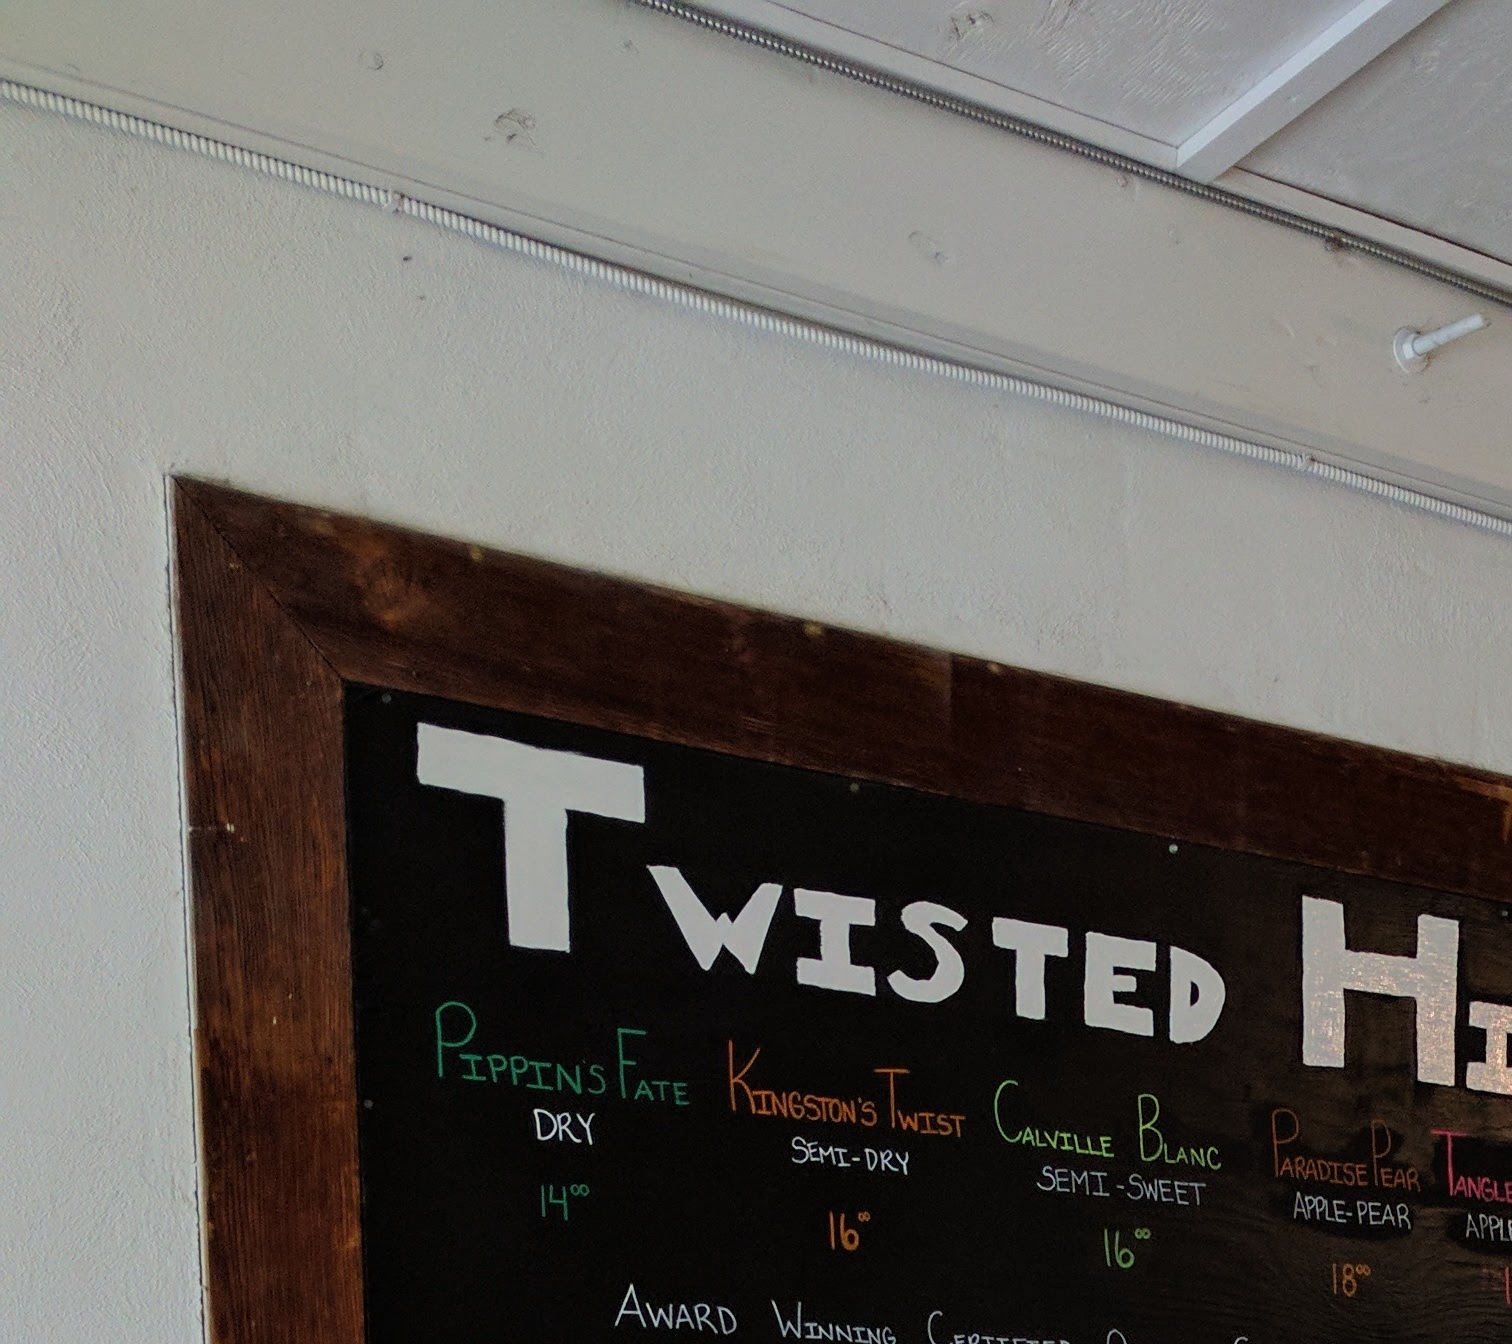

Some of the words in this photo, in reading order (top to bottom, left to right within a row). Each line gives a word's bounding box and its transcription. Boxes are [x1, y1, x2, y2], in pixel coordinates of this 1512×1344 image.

[417, 722, 1227, 1044] TWISTED
[616, 1027, 690, 1106] FATE
[728, 1039, 877, 1128] KINGSTON'S
[874, 1068, 966, 1138] TWIST
[532, 1107, 596, 1146] DRY
[790, 1136, 911, 1177] SEMI-DRY
[994, 1080, 1115, 1158] CALVILLE
[1137, 1093, 1222, 1170] BLANC
[1271, 1108, 1368, 1187] PARADISE
[1371, 1119, 1420, 1193] PEAR
[1292, 1191, 1412, 1230] APPLE-PEAR
[614, 1284, 738, 1336] AWARD
